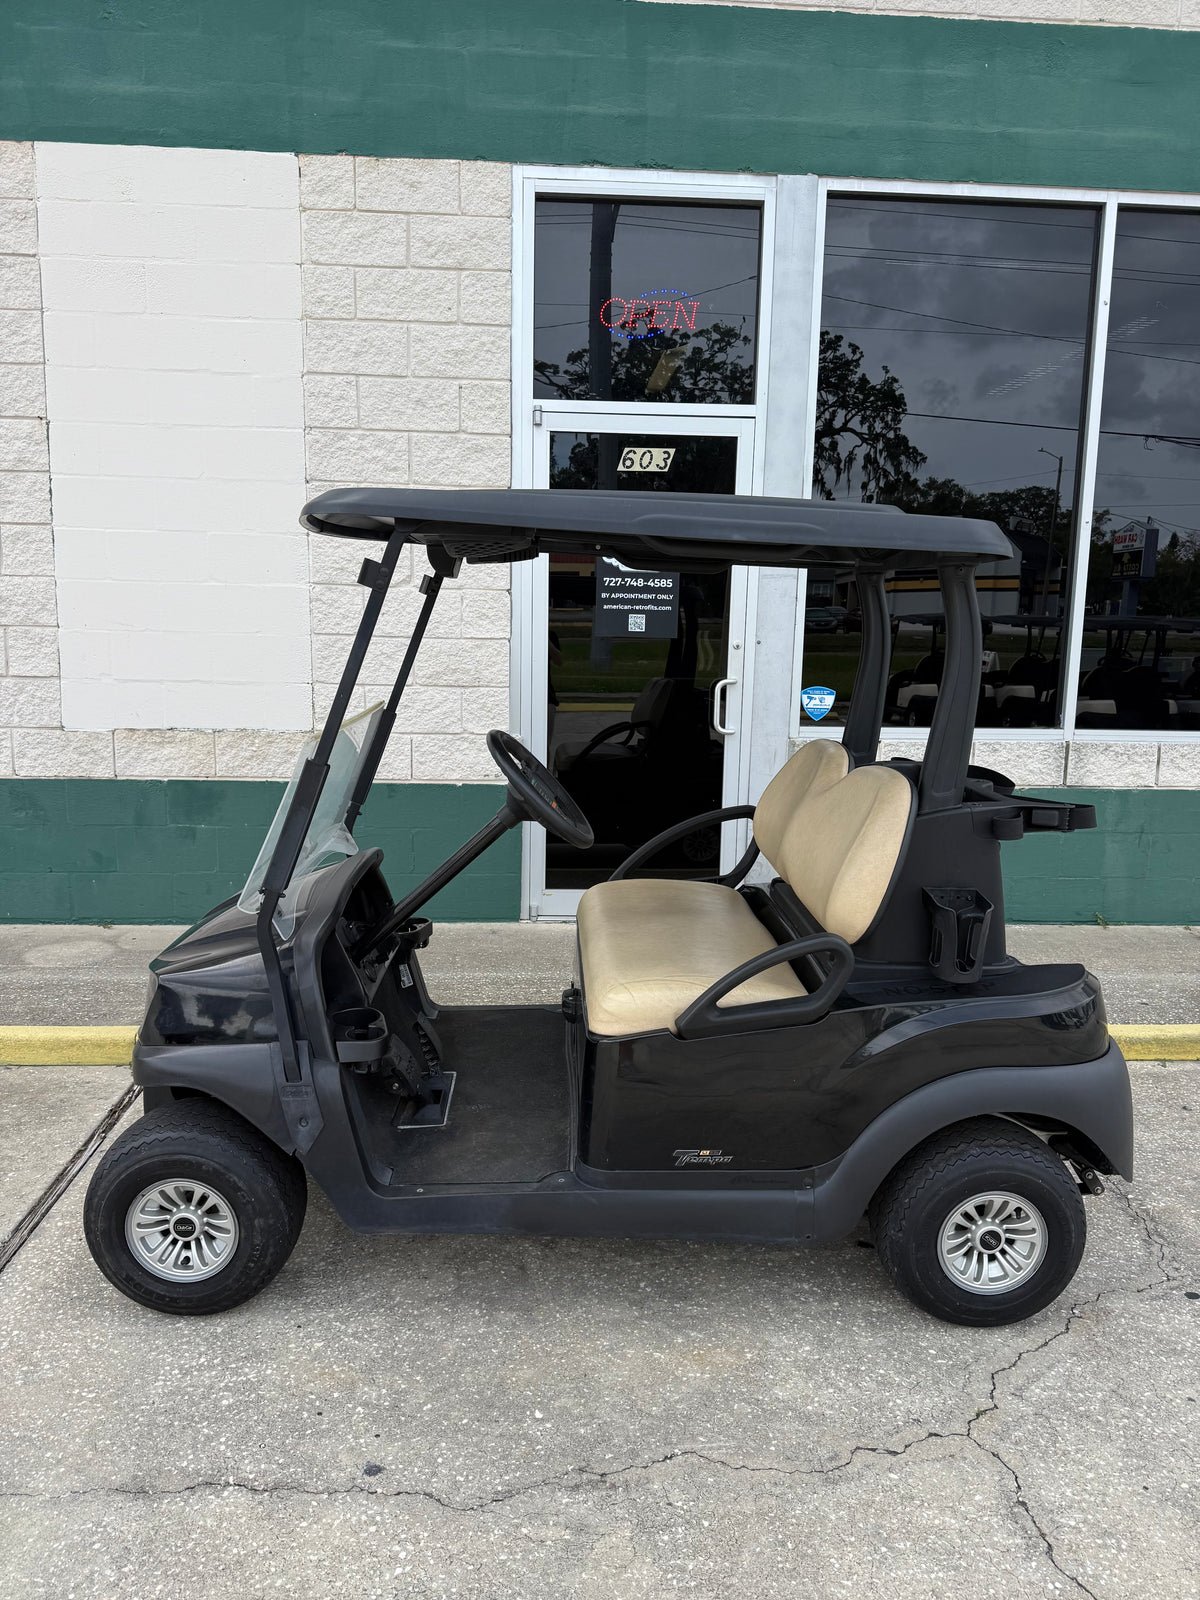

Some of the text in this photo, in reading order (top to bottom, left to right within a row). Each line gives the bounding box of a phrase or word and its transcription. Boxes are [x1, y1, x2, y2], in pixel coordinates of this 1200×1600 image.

[600, 297, 701, 330] OPEN
[621, 449, 672, 470] 603
[603, 577, 673, 588] 727-748-4585
[603, 603, 672, 611] american-retrofits.com
